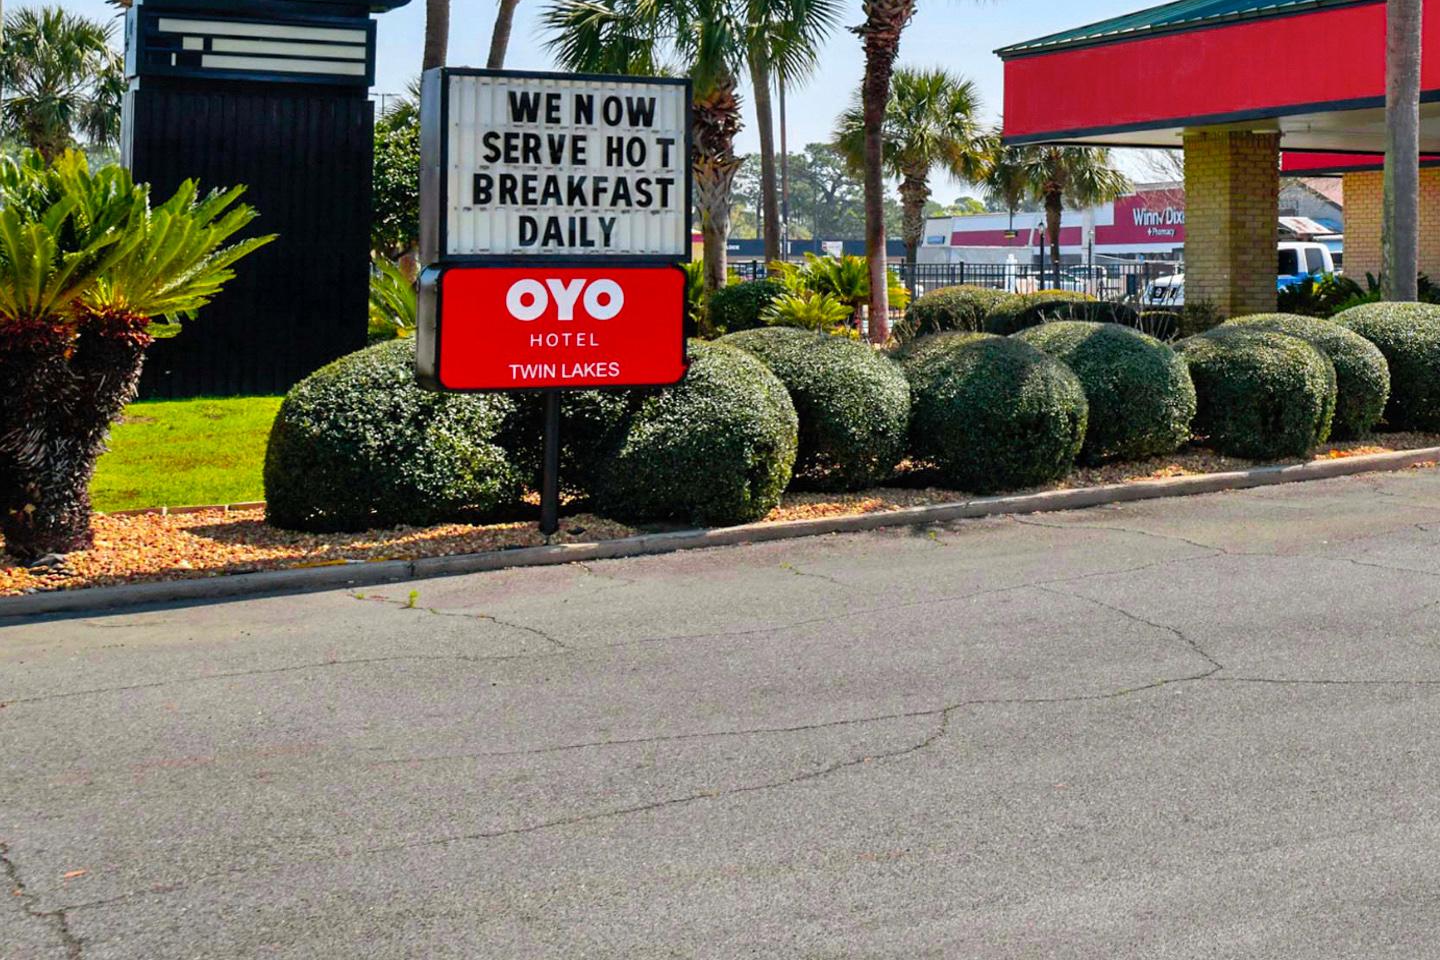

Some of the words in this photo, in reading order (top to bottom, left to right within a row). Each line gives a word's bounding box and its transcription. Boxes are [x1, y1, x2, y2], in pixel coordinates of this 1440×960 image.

[508, 91, 562, 125] WE
[574, 93, 656, 128] NOW
[482, 131, 587, 165] SERVE
[606, 136, 675, 168] HOT
[472, 173, 675, 208] BREAKFAST
[518, 215, 617, 248] DAILY
[506, 278, 625, 321] OYO
[530, 332, 600, 348] HOTEL
[508, 363, 556, 380] TWIN
[561, 361, 620, 378] LAKES
